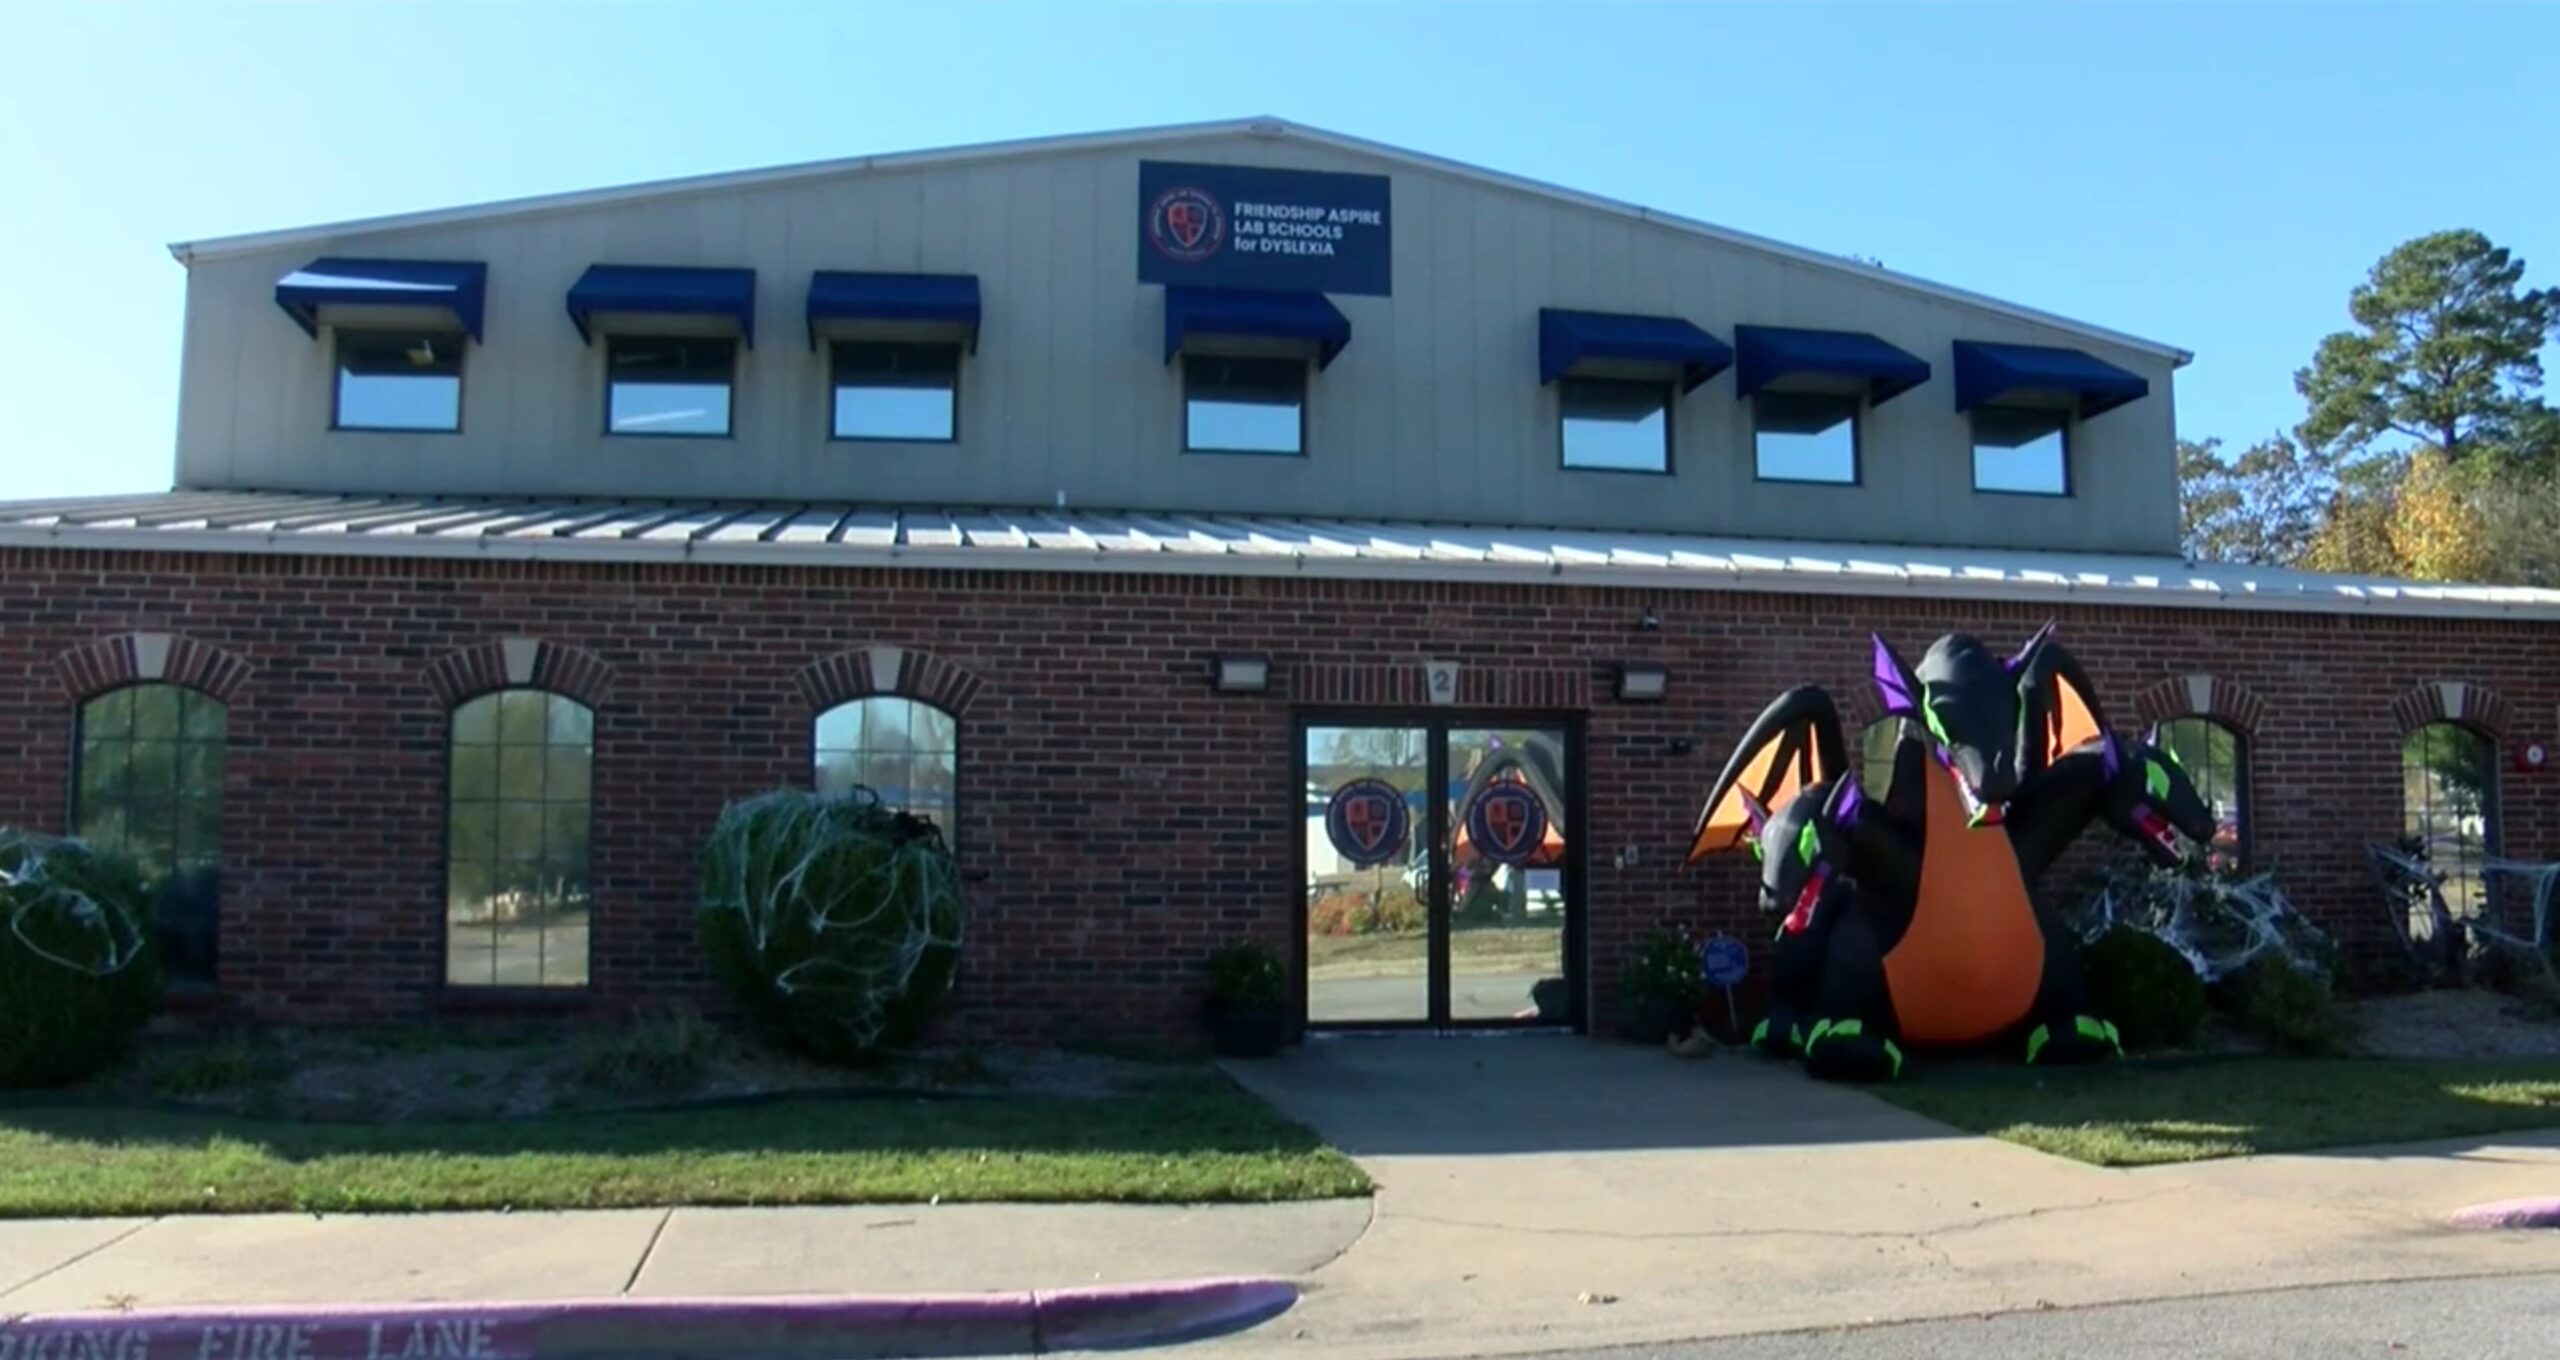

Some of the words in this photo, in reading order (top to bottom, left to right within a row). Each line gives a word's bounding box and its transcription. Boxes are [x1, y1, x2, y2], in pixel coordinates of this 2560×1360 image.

[1234, 202, 1325, 220] FRIENDSHIP
[1328, 209, 1381, 225] ASPIRE
[1234, 219, 1264, 235] LAB
[1268, 222, 1342, 240] SCHOOLS
[1234, 236, 1257, 251] for
[1260, 238, 1334, 256] DYSLEXIA
[1432, 670, 1449, 692] 2
[199, 1323, 321, 1360] FIRE
[366, 1319, 499, 1360] LANE
